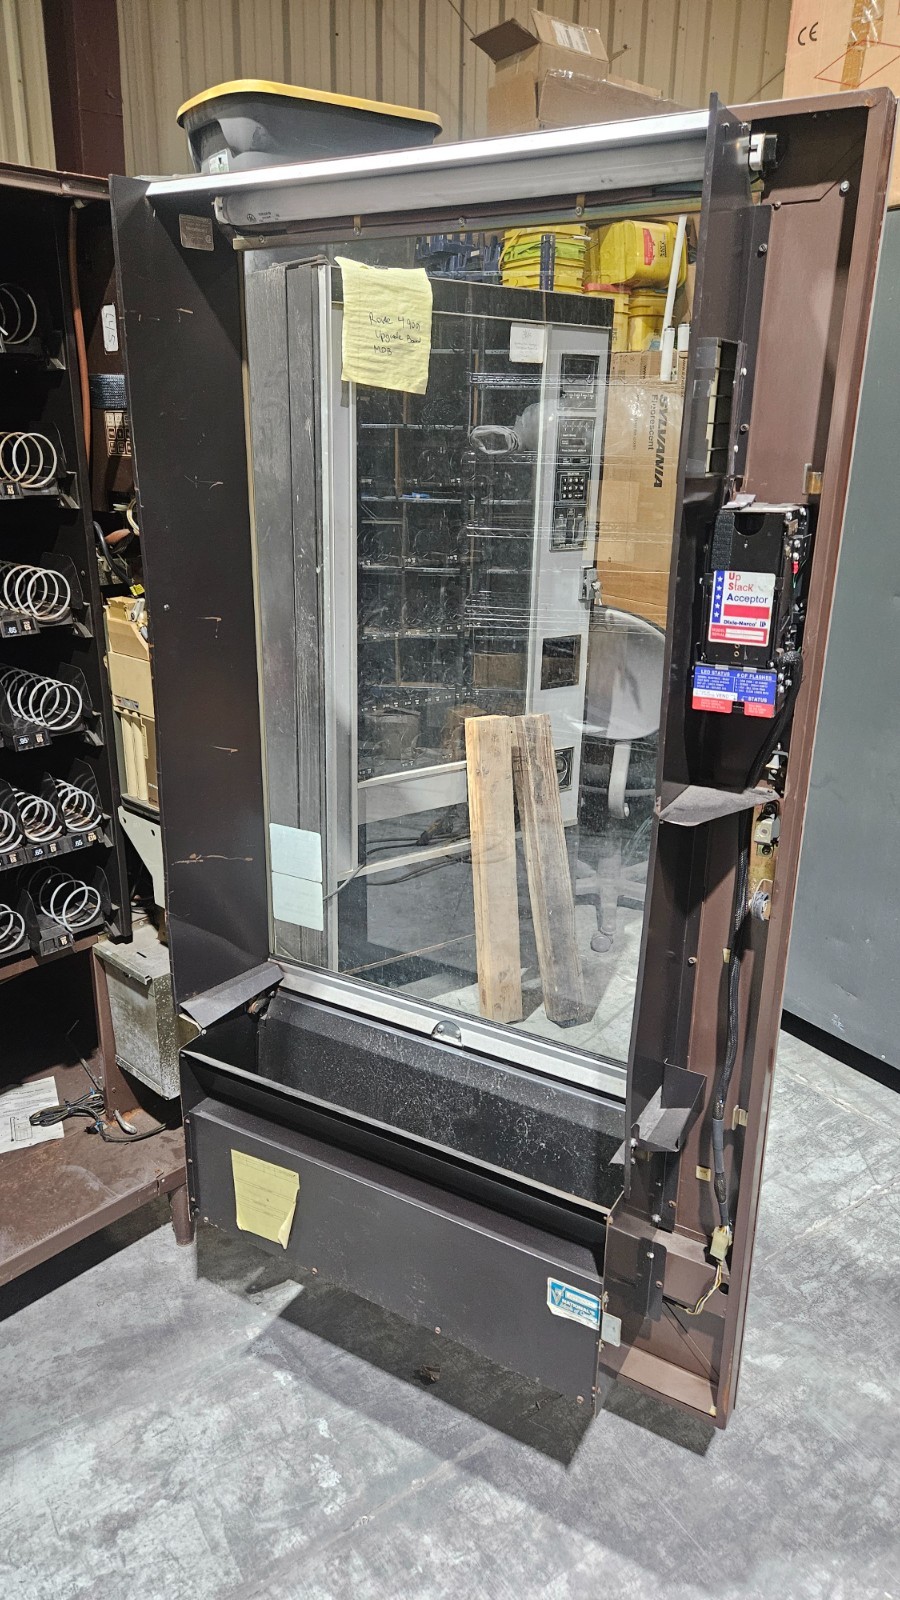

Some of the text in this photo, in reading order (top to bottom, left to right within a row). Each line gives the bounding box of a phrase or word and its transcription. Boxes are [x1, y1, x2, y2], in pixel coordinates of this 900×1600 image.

[797, 22, 819, 47] CE
[648, 395, 658, 451] Fluorescent
[654, 394, 668, 488] SYLVANIA
[728, 572, 741, 582] Up
[728, 581, 754, 592] Stack
[727, 593, 769, 604] Acceptor
[723, 619, 757, 627] Dixie-Narco
